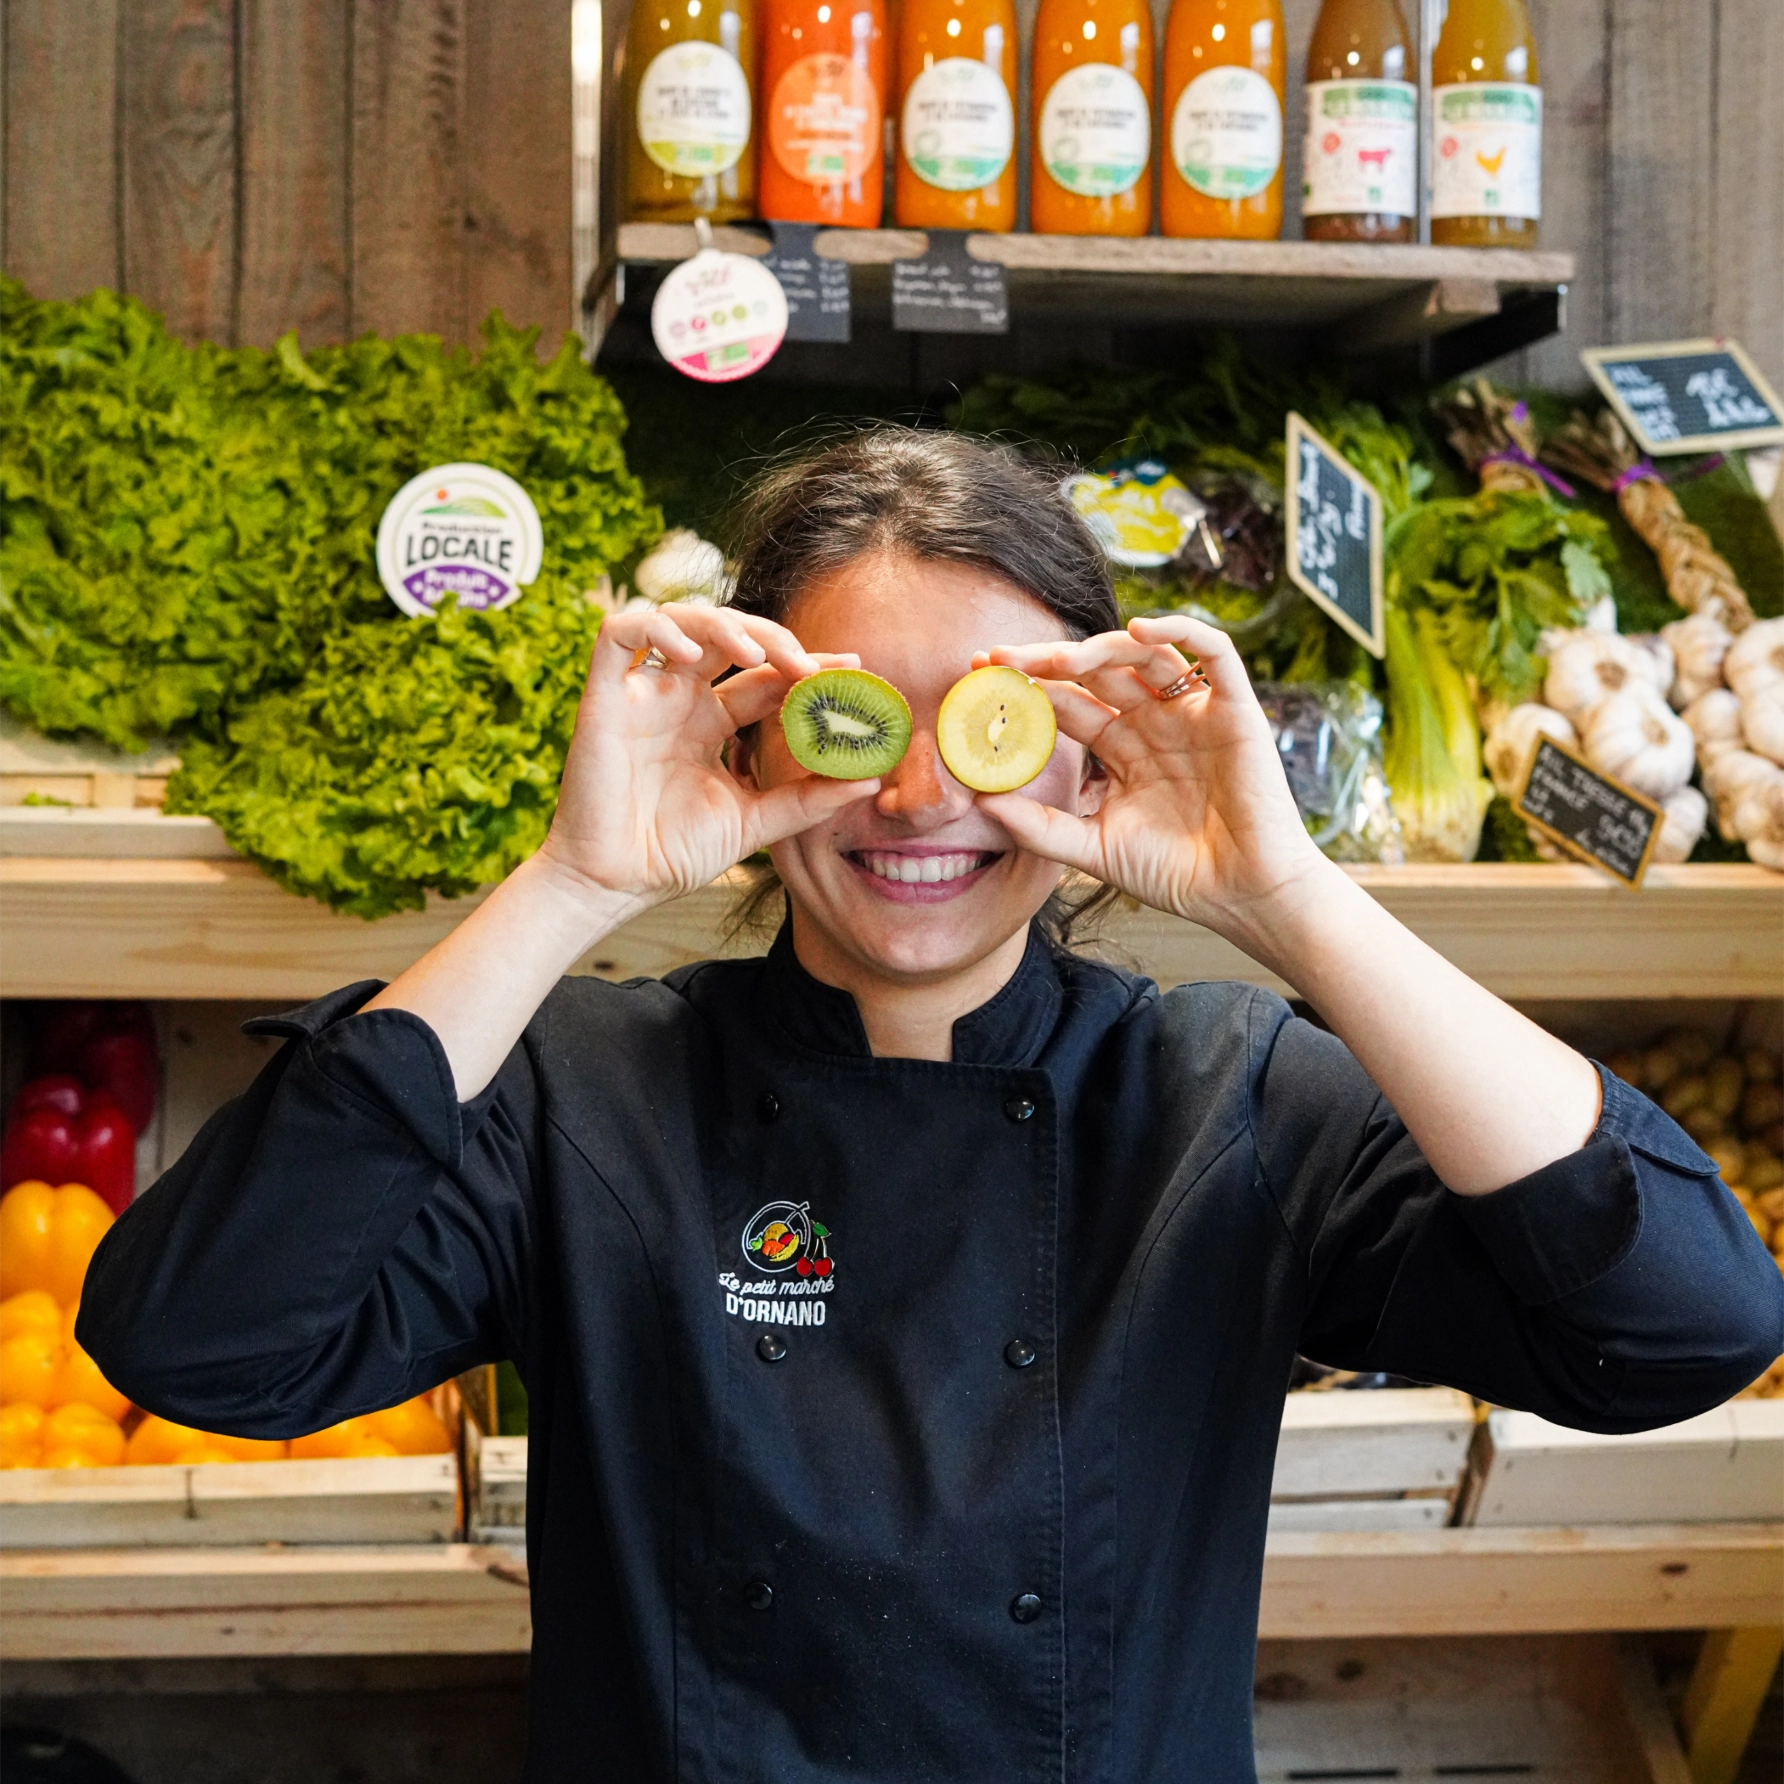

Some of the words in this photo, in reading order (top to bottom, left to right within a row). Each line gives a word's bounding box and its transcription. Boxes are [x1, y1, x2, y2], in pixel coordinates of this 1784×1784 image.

[406, 534, 514, 573] LOCALE
[718, 1272, 741, 1292] Le
[740, 1279, 777, 1296] petit
[778, 1275, 835, 1295] marché
[726, 1292, 826, 1327] D'ORNANO
